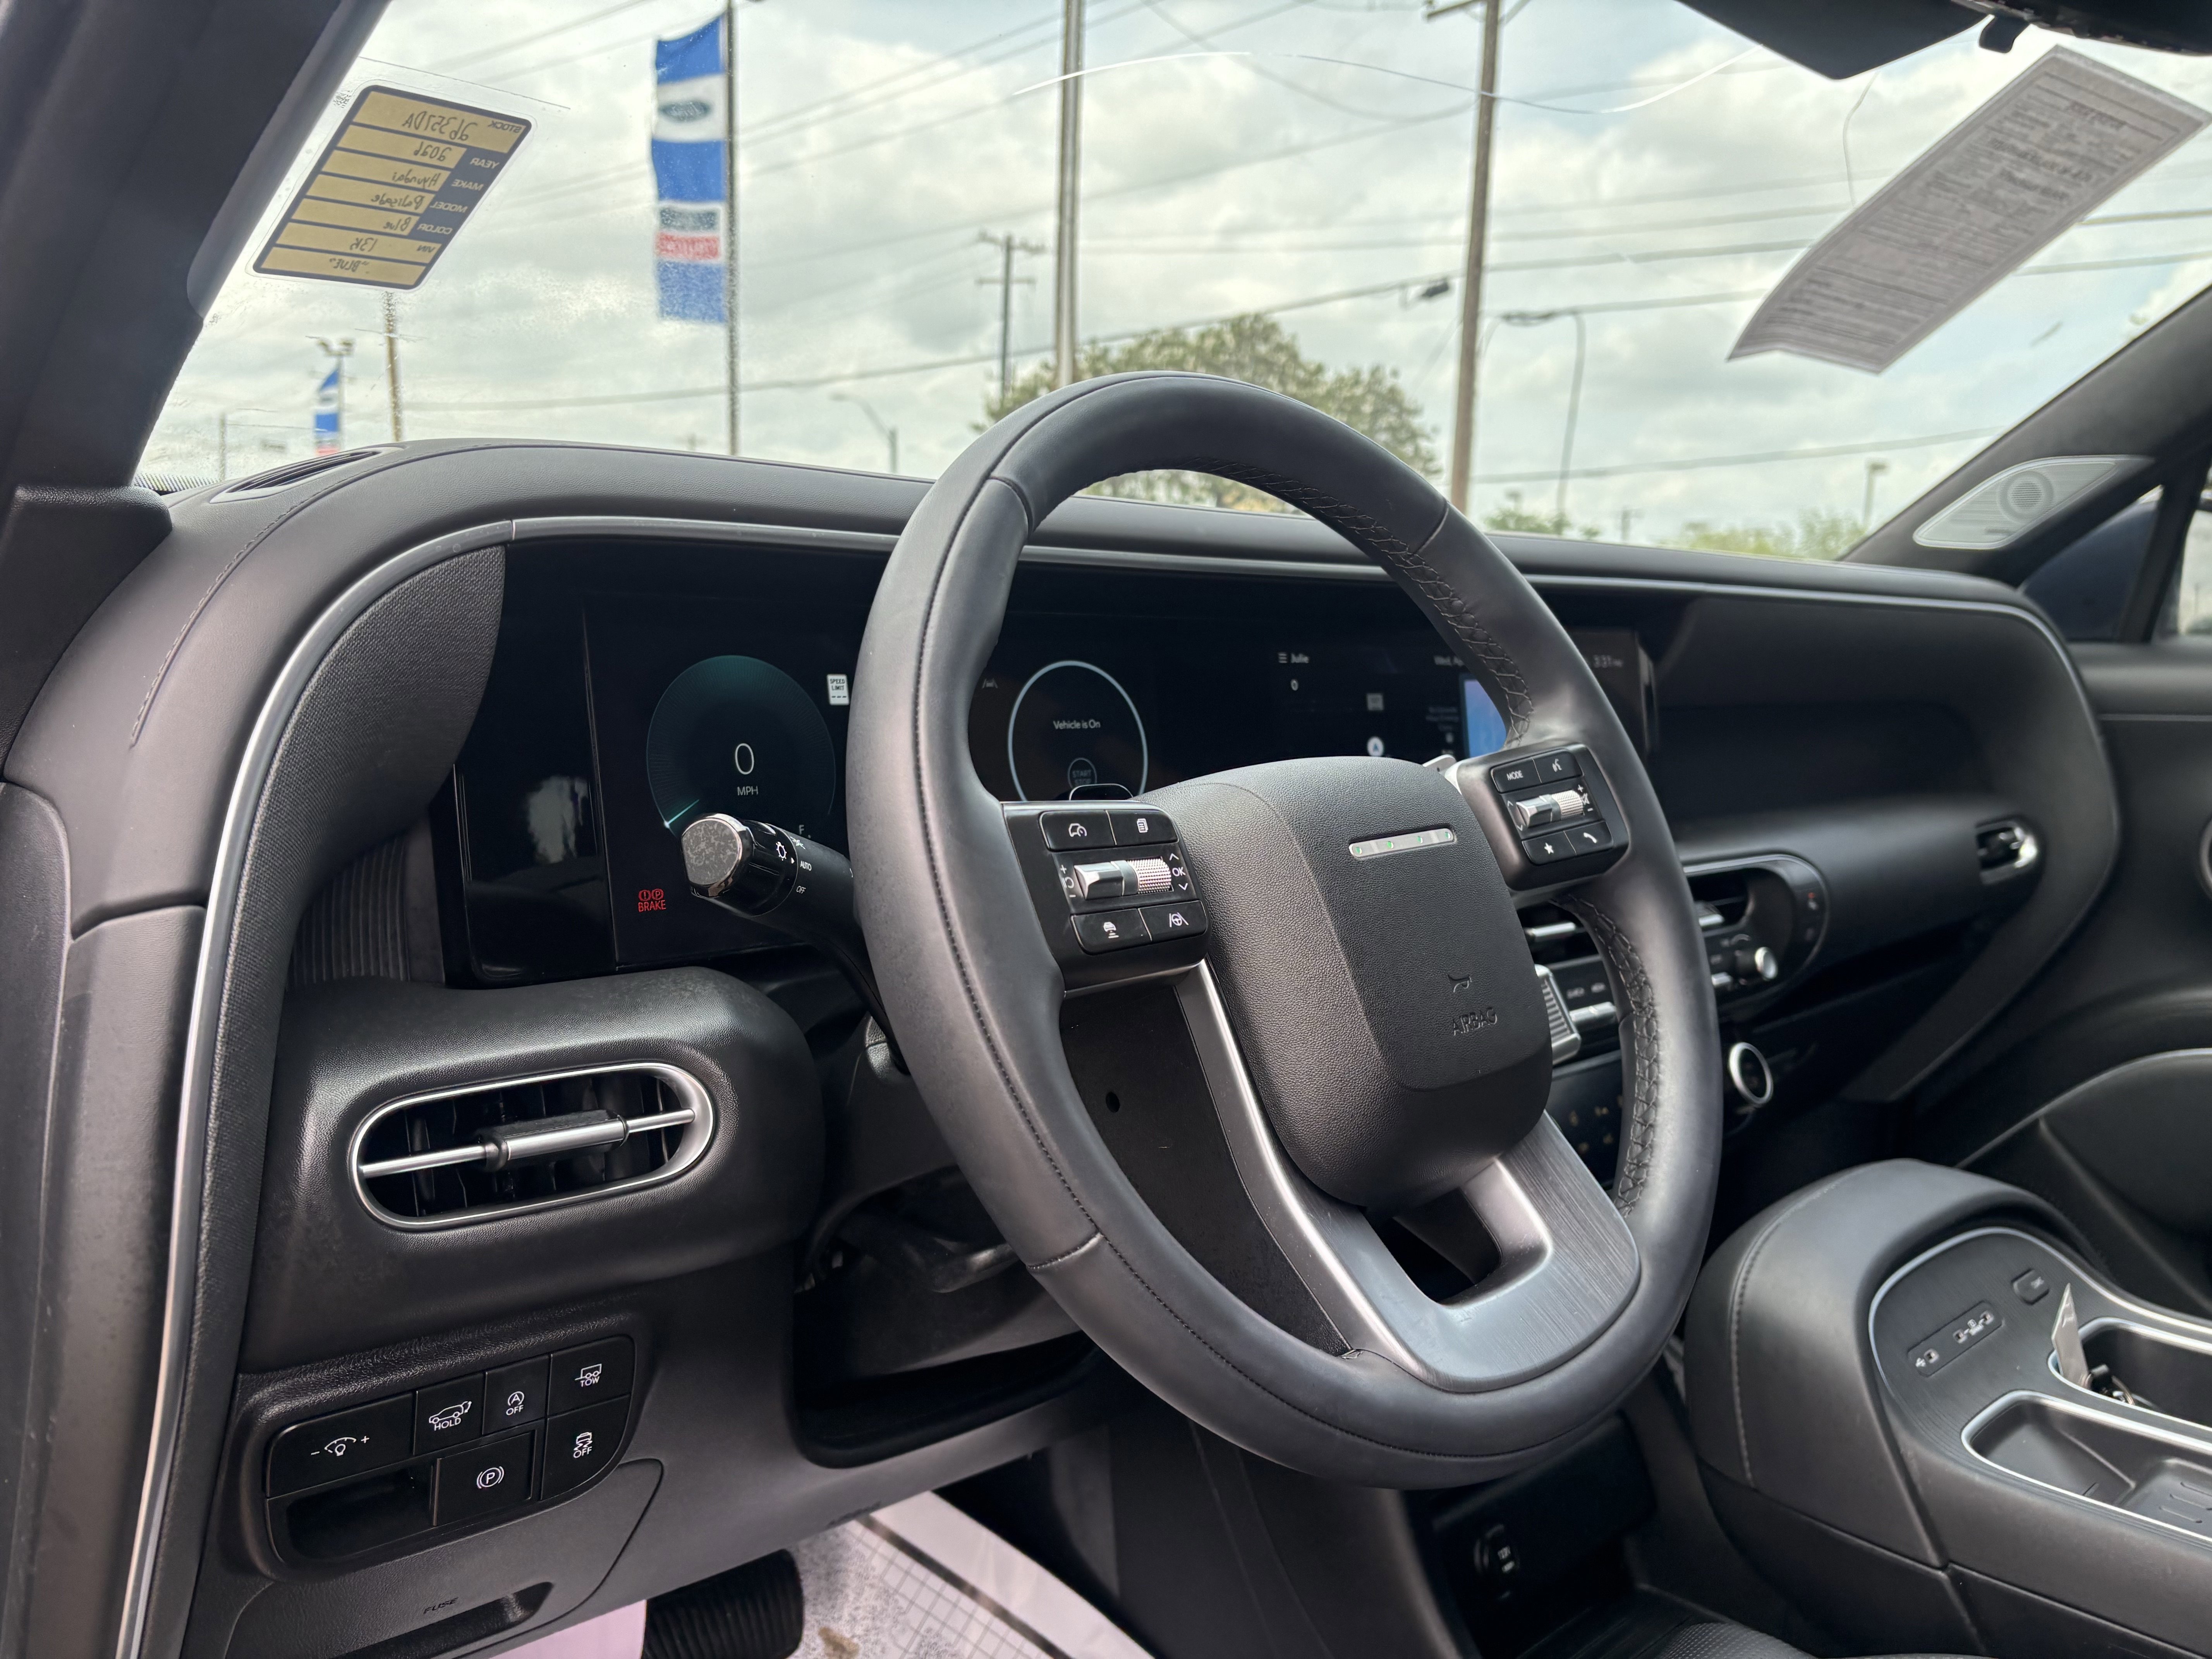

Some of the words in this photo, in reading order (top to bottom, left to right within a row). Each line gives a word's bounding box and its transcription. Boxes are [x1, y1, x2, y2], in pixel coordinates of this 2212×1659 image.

[1053, 720, 1080, 730] Vehicle
[1082, 720, 1088, 728] is
[1089, 719, 1101, 728] On
[735, 743, 755, 775] 0
[1072, 769, 1091, 778] START
[1506, 770, 1523, 781] MODE
[737, 786, 759, 796] MPH
[800, 860, 812, 871] AUTO
[1172, 867, 1186, 877] OK
[796, 885, 806, 894] OFF
[638, 900, 666, 912] BRAKE
[1452, 1006, 1498, 1036] AIRBAG
[579, 1377, 600, 1387] TOW
[505, 1404, 524, 1416] OFF
[434, 1417, 462, 1431] HOLD
[573, 1445, 592, 1458] OFF
[423, 1597, 458, 1614] FUSE
